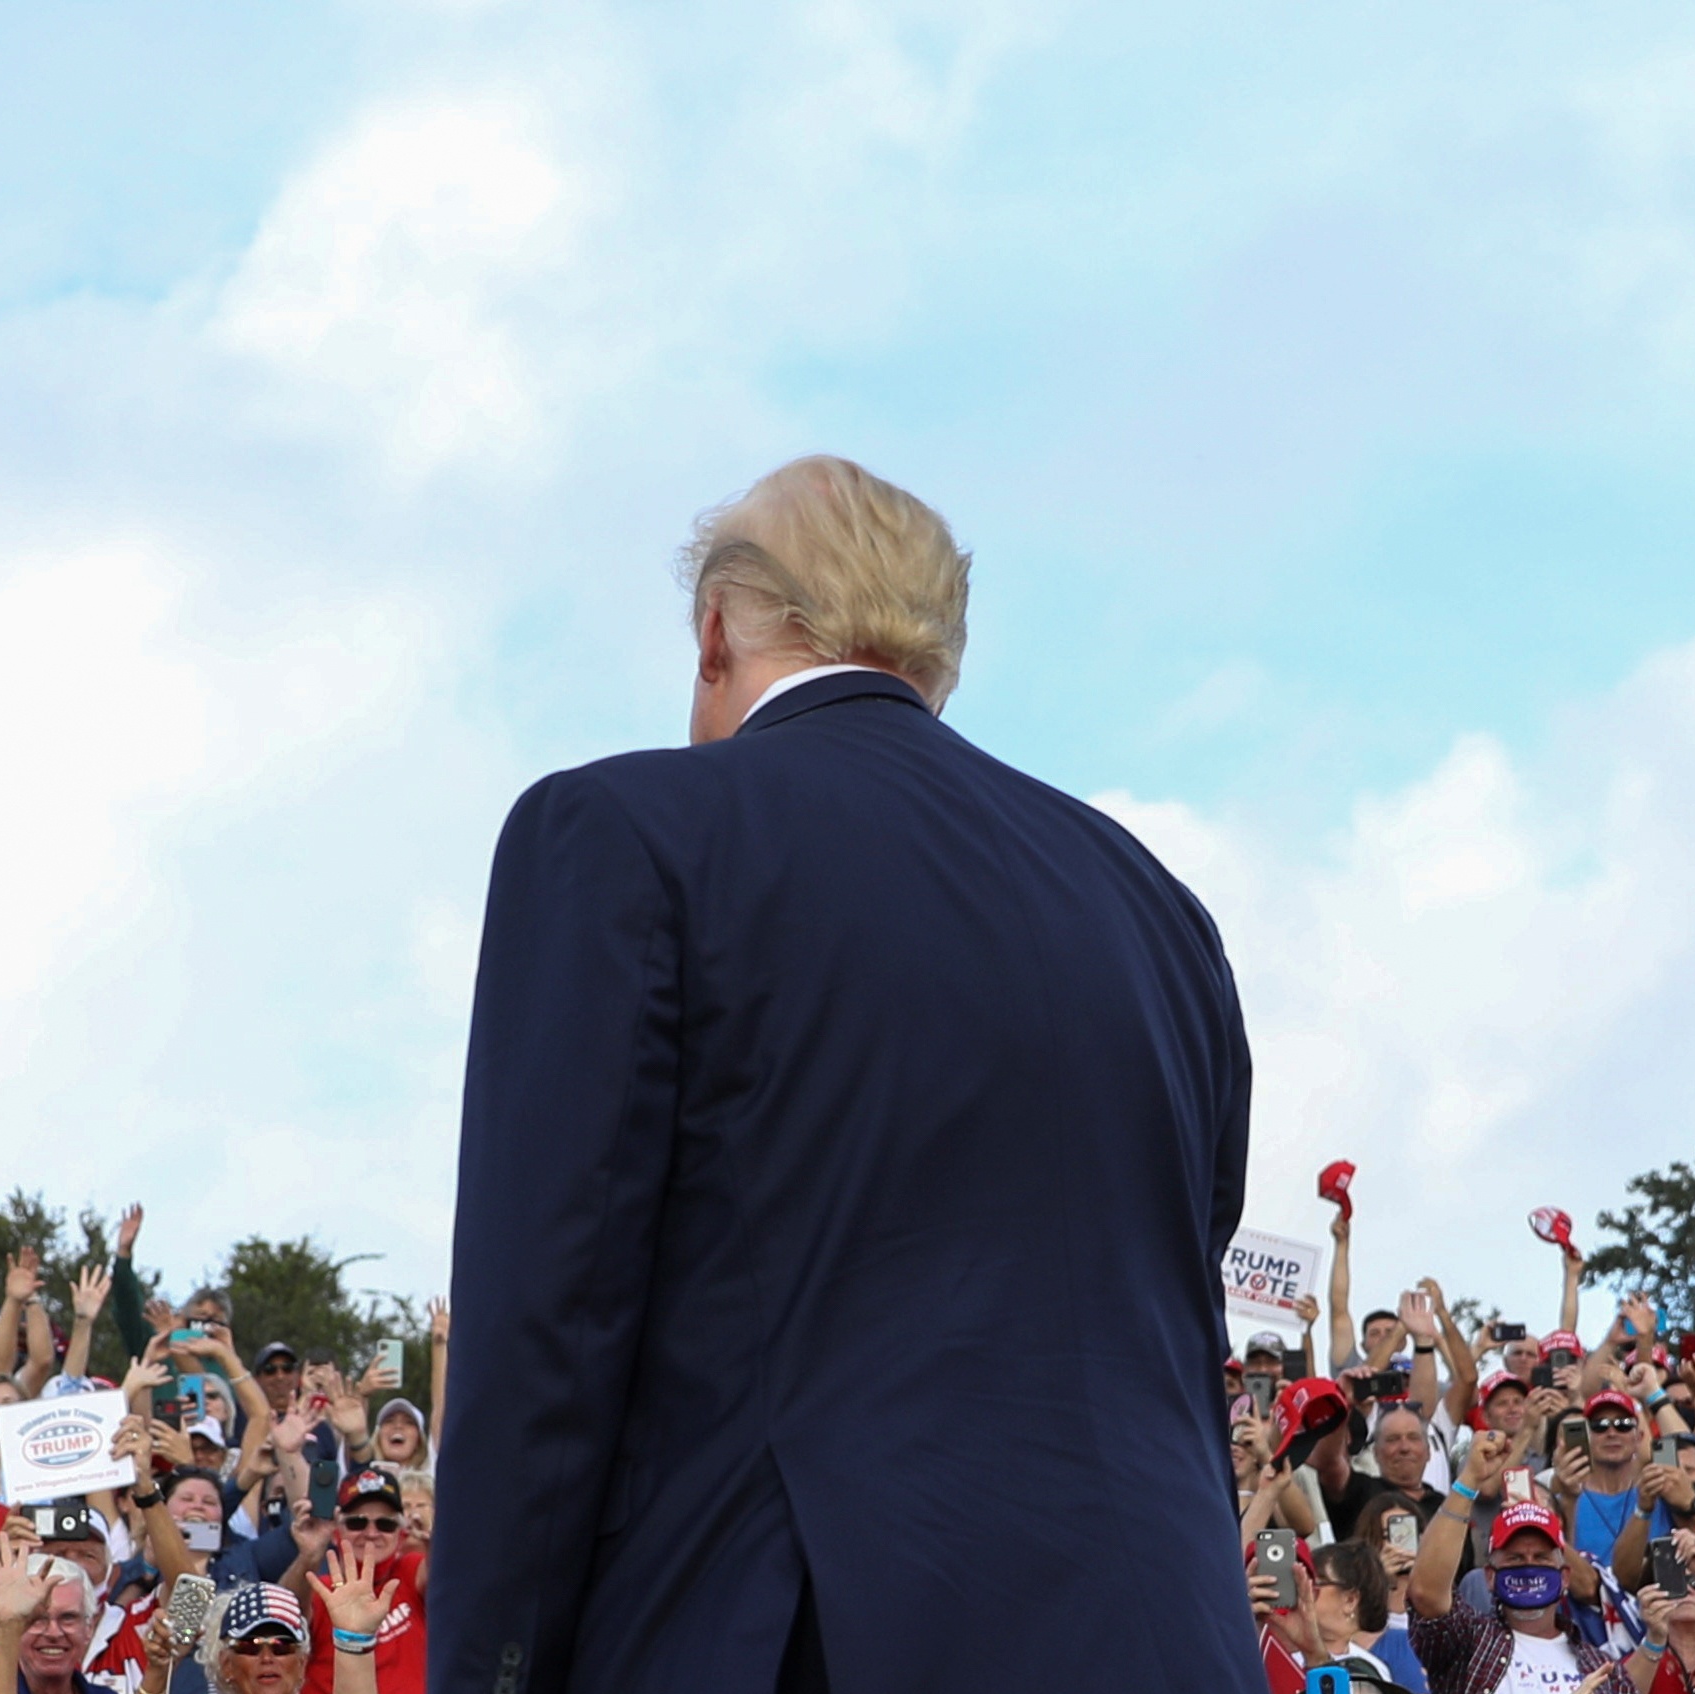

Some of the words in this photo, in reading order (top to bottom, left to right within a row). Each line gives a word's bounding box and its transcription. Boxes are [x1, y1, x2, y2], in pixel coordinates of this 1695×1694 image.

[1227, 1246, 1300, 1278] RUMP
[1235, 1268, 1298, 1299] VOTE
[30, 1435, 93, 1456] TRUMP
[378, 1602, 412, 1633] UMP
